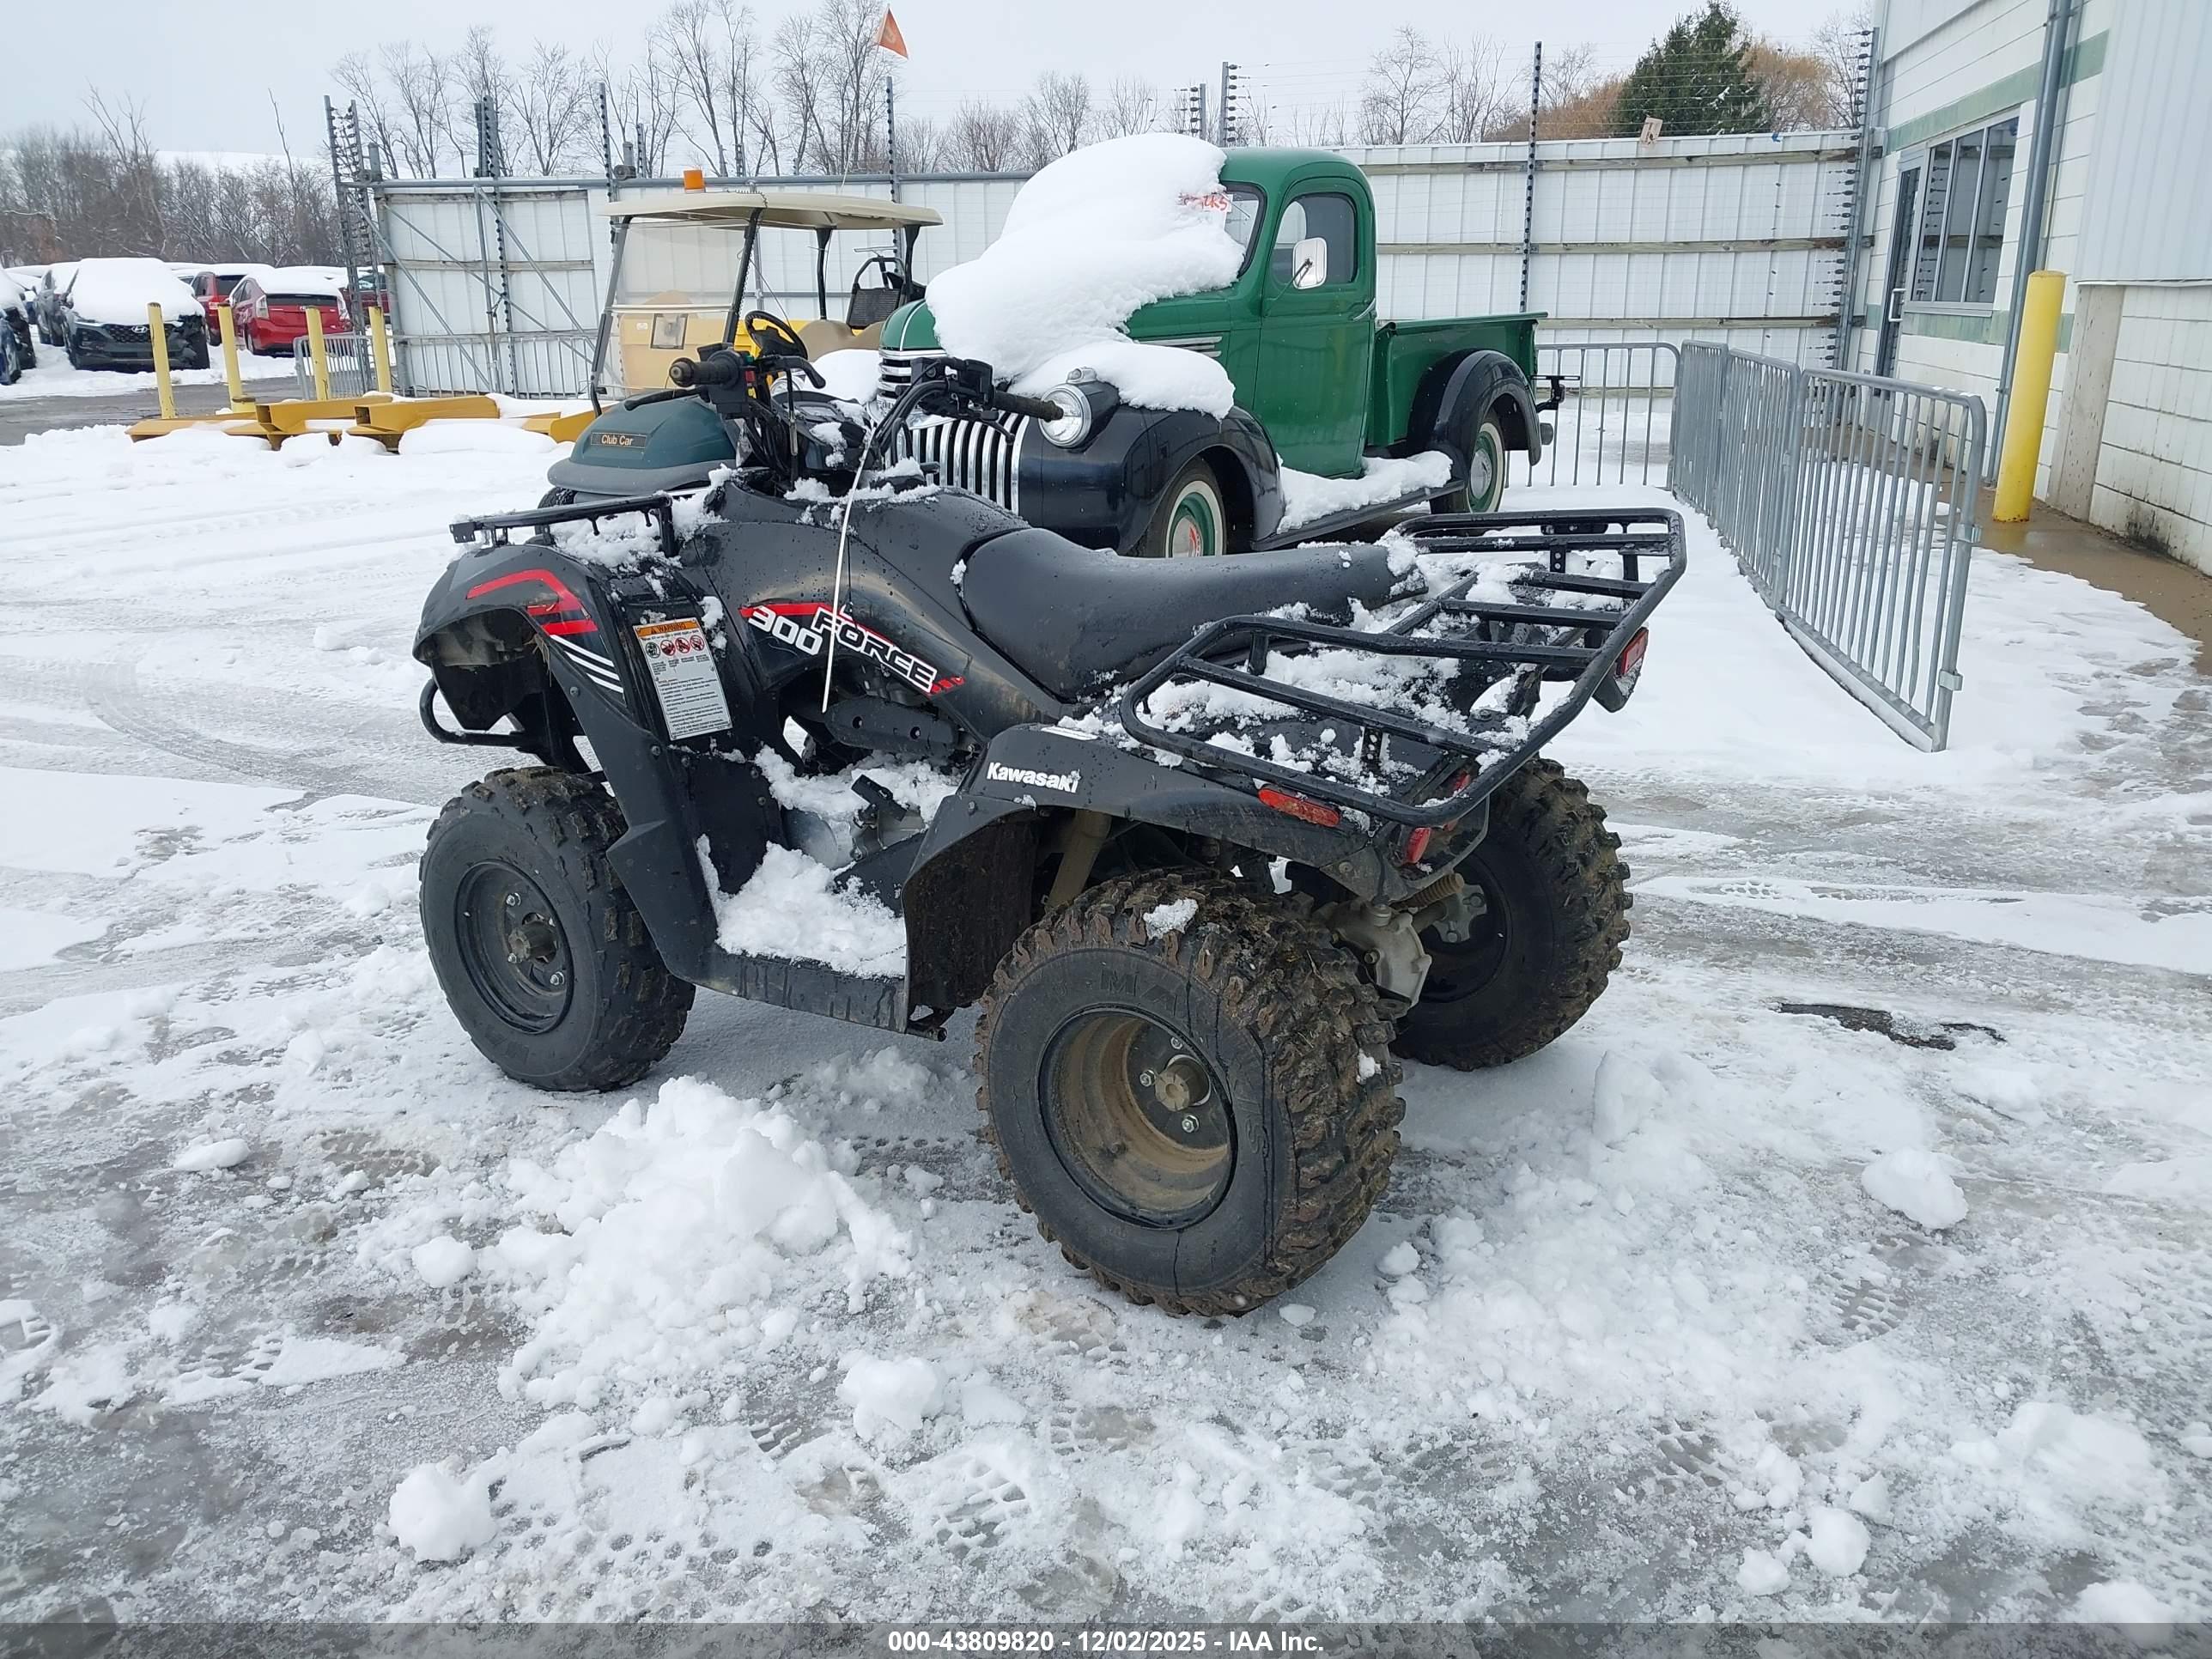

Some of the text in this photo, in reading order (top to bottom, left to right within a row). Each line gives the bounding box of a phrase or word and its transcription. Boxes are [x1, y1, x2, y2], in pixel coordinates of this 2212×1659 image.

[601, 434, 634, 446] Club Car
[658, 622, 687, 633] WARNING
[748, 605, 938, 693] 300 FORCE
[987, 762, 1080, 793] Kawasaki
